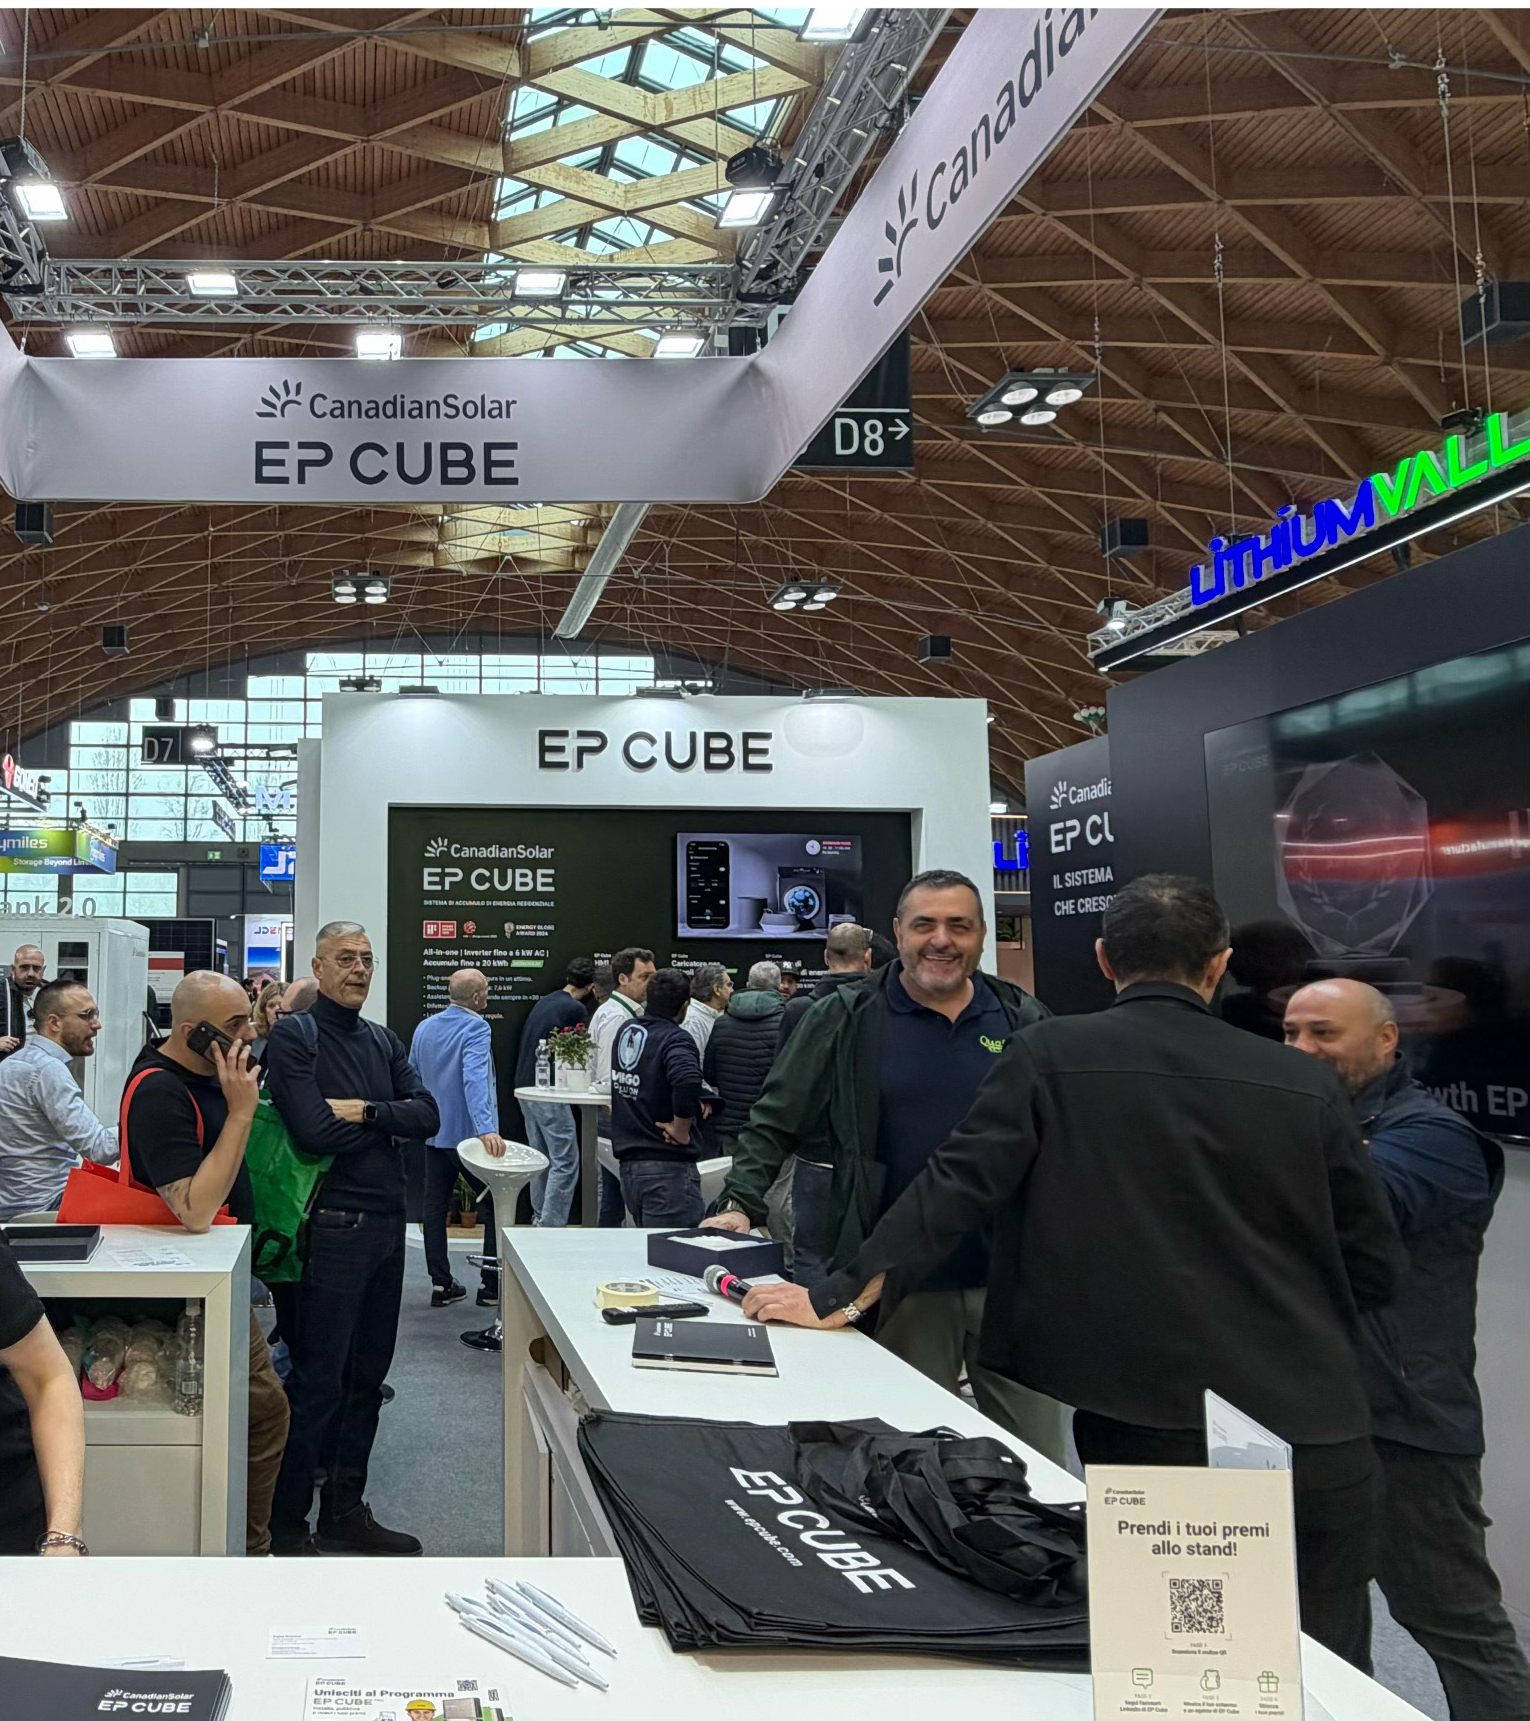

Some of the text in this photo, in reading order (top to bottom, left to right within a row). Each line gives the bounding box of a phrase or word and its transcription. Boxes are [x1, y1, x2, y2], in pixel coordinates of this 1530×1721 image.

[308, 393, 518, 420] CanadianSolar
[833, 418, 885, 457] D8
[254, 440, 520, 486] EP CUBE
[143, 737, 174, 763] D7
[538, 729, 774, 773] EP CUBE
[13, 857, 72, 867] Storage Beyond
[450, 843, 555, 859] CanadianSolar
[423, 867, 556, 892] EP CUBE
[1053, 865, 1114, 889] IL SISTEMA
[58, 896, 97, 919] 2.0
[1104, 1497, 1146, 1506] EP CUBE
[724, 1498, 804, 1567] www.epcube.com
[729, 1466, 917, 1594] EP CUBE
[1117, 1520, 1270, 1540] Prendi i tuoi premi
[1151, 1540, 1238, 1557] allo stand!
[122, 1692, 195, 1701] CanadianSolar
[313, 1698, 373, 1706] EP CUBE
[314, 1688, 455, 1699] Unisciti al Programma
[97, 1700, 193, 1713] EP CUBE
